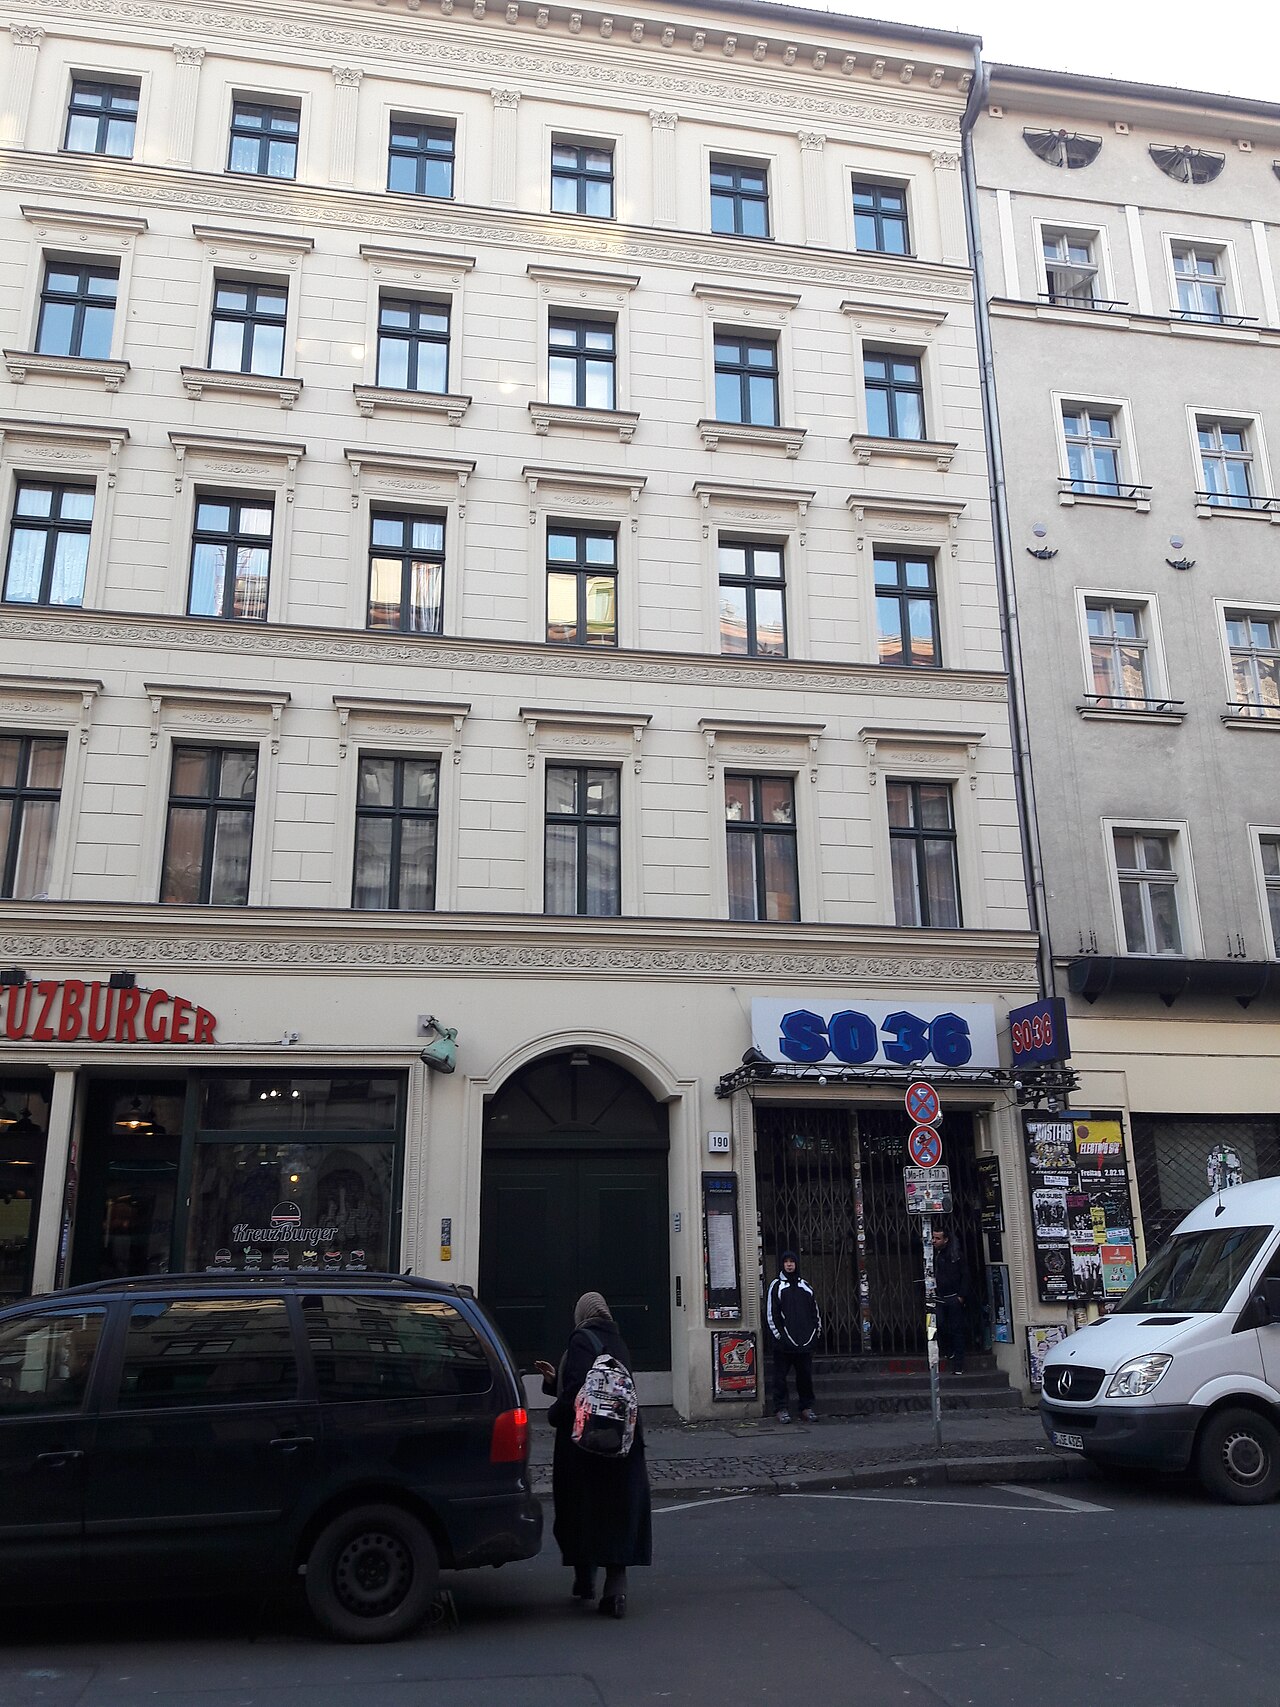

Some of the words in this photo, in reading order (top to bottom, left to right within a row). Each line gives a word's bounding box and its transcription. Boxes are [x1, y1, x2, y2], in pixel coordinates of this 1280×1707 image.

[0, 979, 217, 1044] UZBURGER
[713, 1136, 728, 1148] 190
[1081, 1169, 1102, 1177] Freitag
[231, 1222, 339, 1247] KreuzBurger
